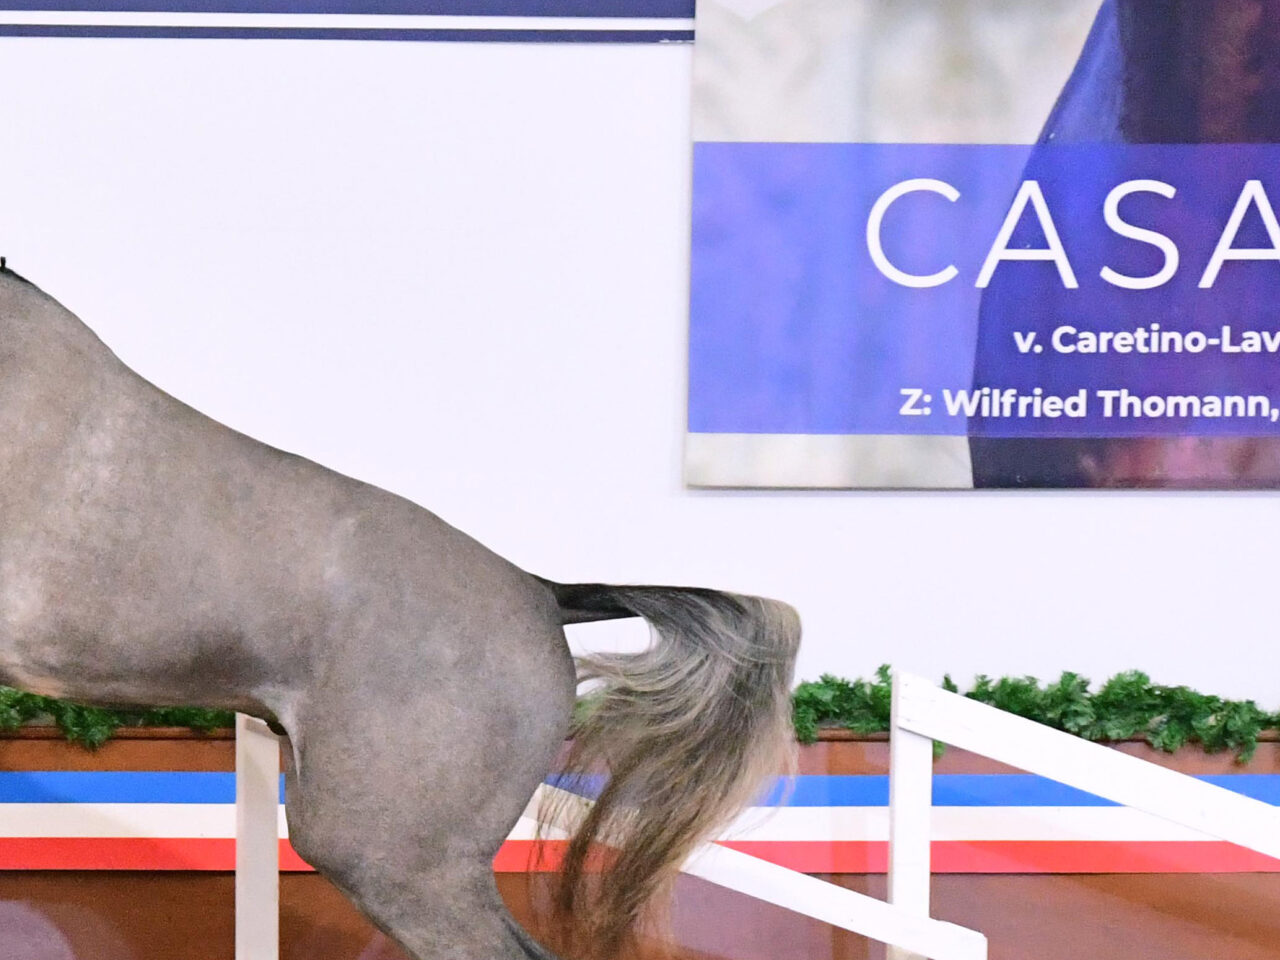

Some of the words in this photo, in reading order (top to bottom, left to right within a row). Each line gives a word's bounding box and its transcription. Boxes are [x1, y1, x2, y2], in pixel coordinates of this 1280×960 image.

[866, 178, 1280, 290] CASA
[1013, 331, 1043, 354] v.
[1052, 323, 1280, 354] Caretino-Lav
[899, 389, 932, 416] Z:
[942, 387, 1087, 418] Wilfried
[1097, 389, 1279, 421] Thomann,
